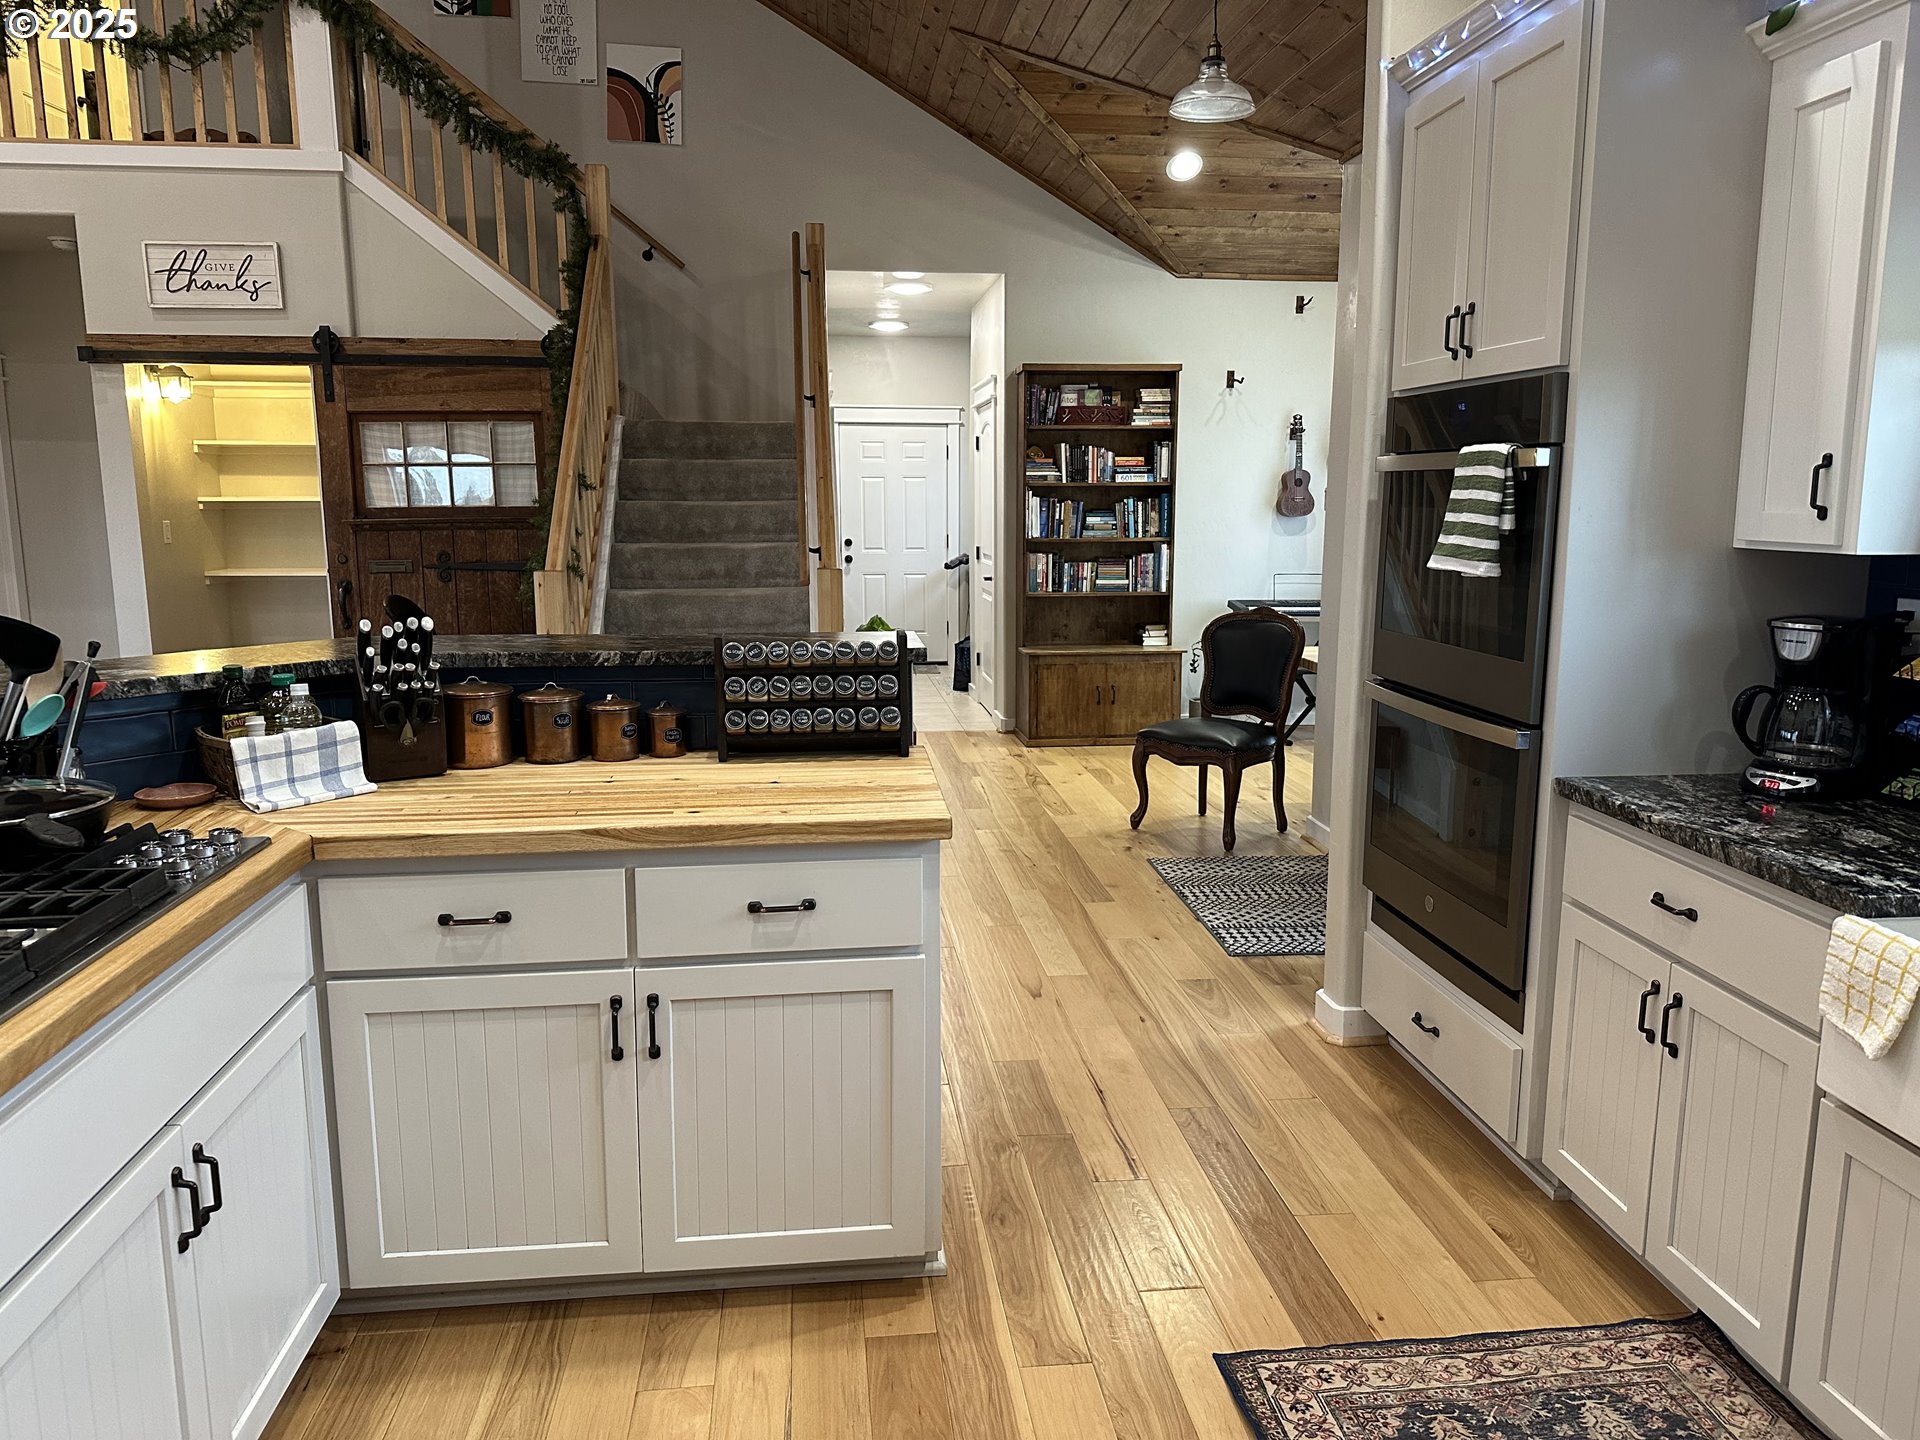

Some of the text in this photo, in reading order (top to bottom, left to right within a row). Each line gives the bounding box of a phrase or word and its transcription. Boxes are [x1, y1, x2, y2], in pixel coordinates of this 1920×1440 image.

[540, 15, 573, 26] WHO GIVES
[543, 25, 571, 36] WHAT HE
[536, 34, 577, 46] CANNOT KEEP
[536, 45, 581, 56] TO GAIN WHAT
[541, 54, 577, 66] HE CANNOT
[553, 66, 568, 76] LOSE
[204, 263, 235, 272] GIVE
[154, 248, 272, 302] thanks
